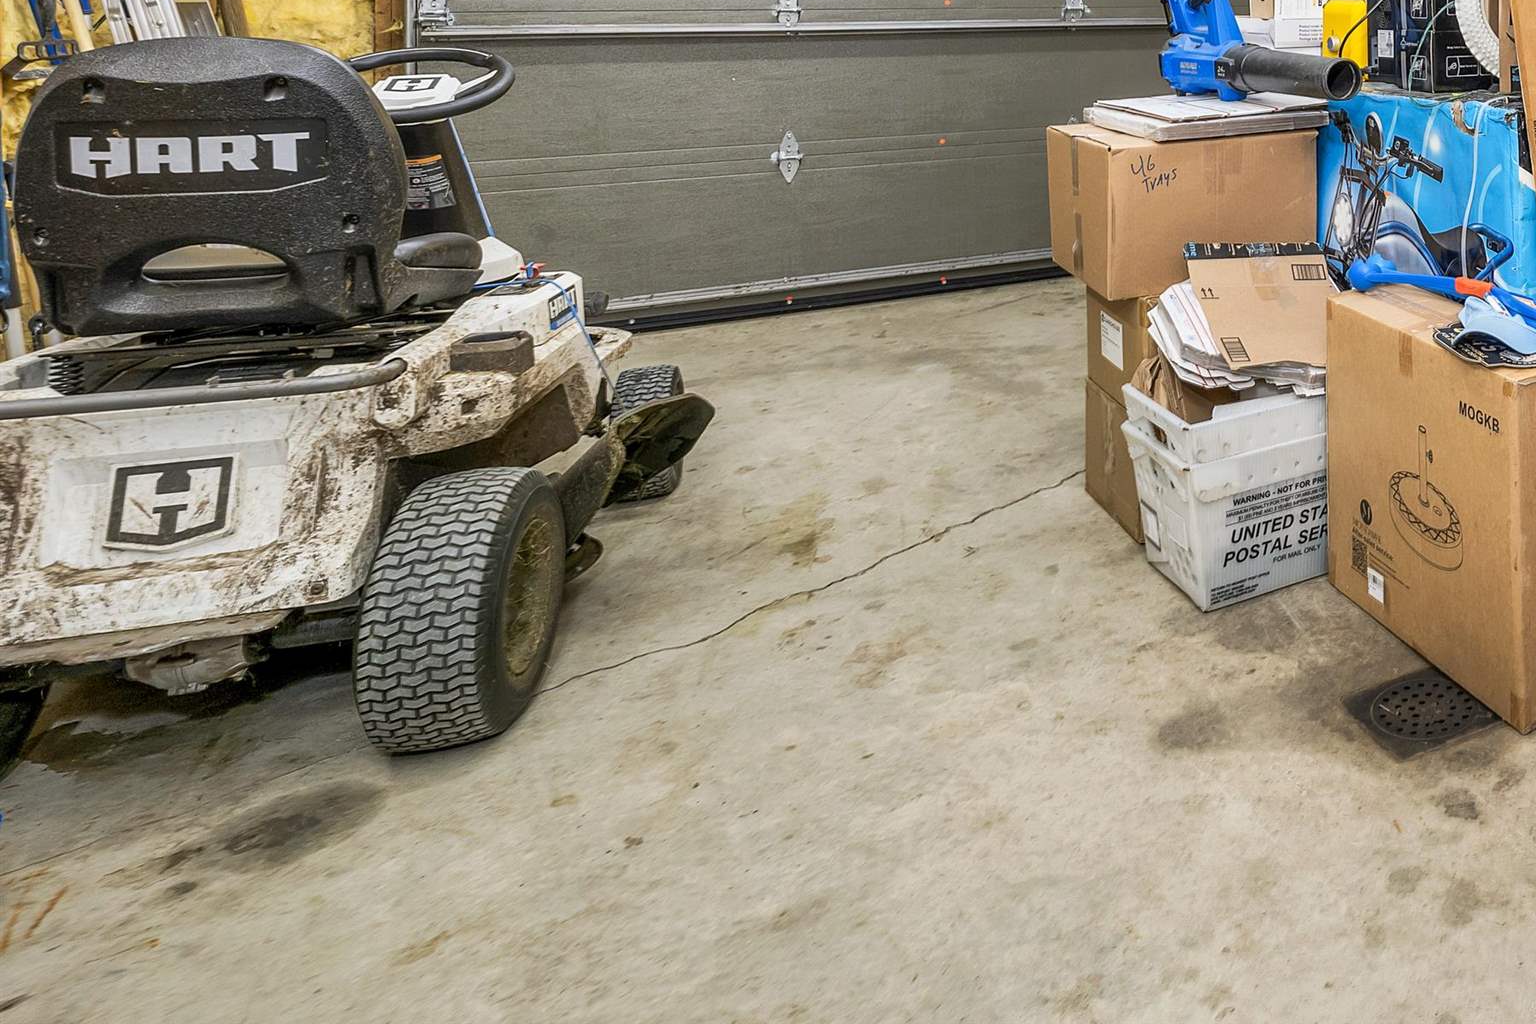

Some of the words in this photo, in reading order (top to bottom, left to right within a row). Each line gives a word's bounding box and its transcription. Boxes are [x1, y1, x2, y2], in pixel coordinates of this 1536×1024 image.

[69, 131, 309, 180] HART
[1458, 400, 1501, 434] MOGKB
[1232, 489, 1272, 507] WARNING
[1277, 483, 1294, 495] NOT
[1294, 479, 1311, 491] FOR
[1231, 514, 1295, 544] UNITED
[1223, 534, 1293, 568] POSTAL
[1273, 554, 1287, 564] FOR
[1288, 550, 1303, 560] MAIL
[1303, 543, 1322, 554] ONLY
